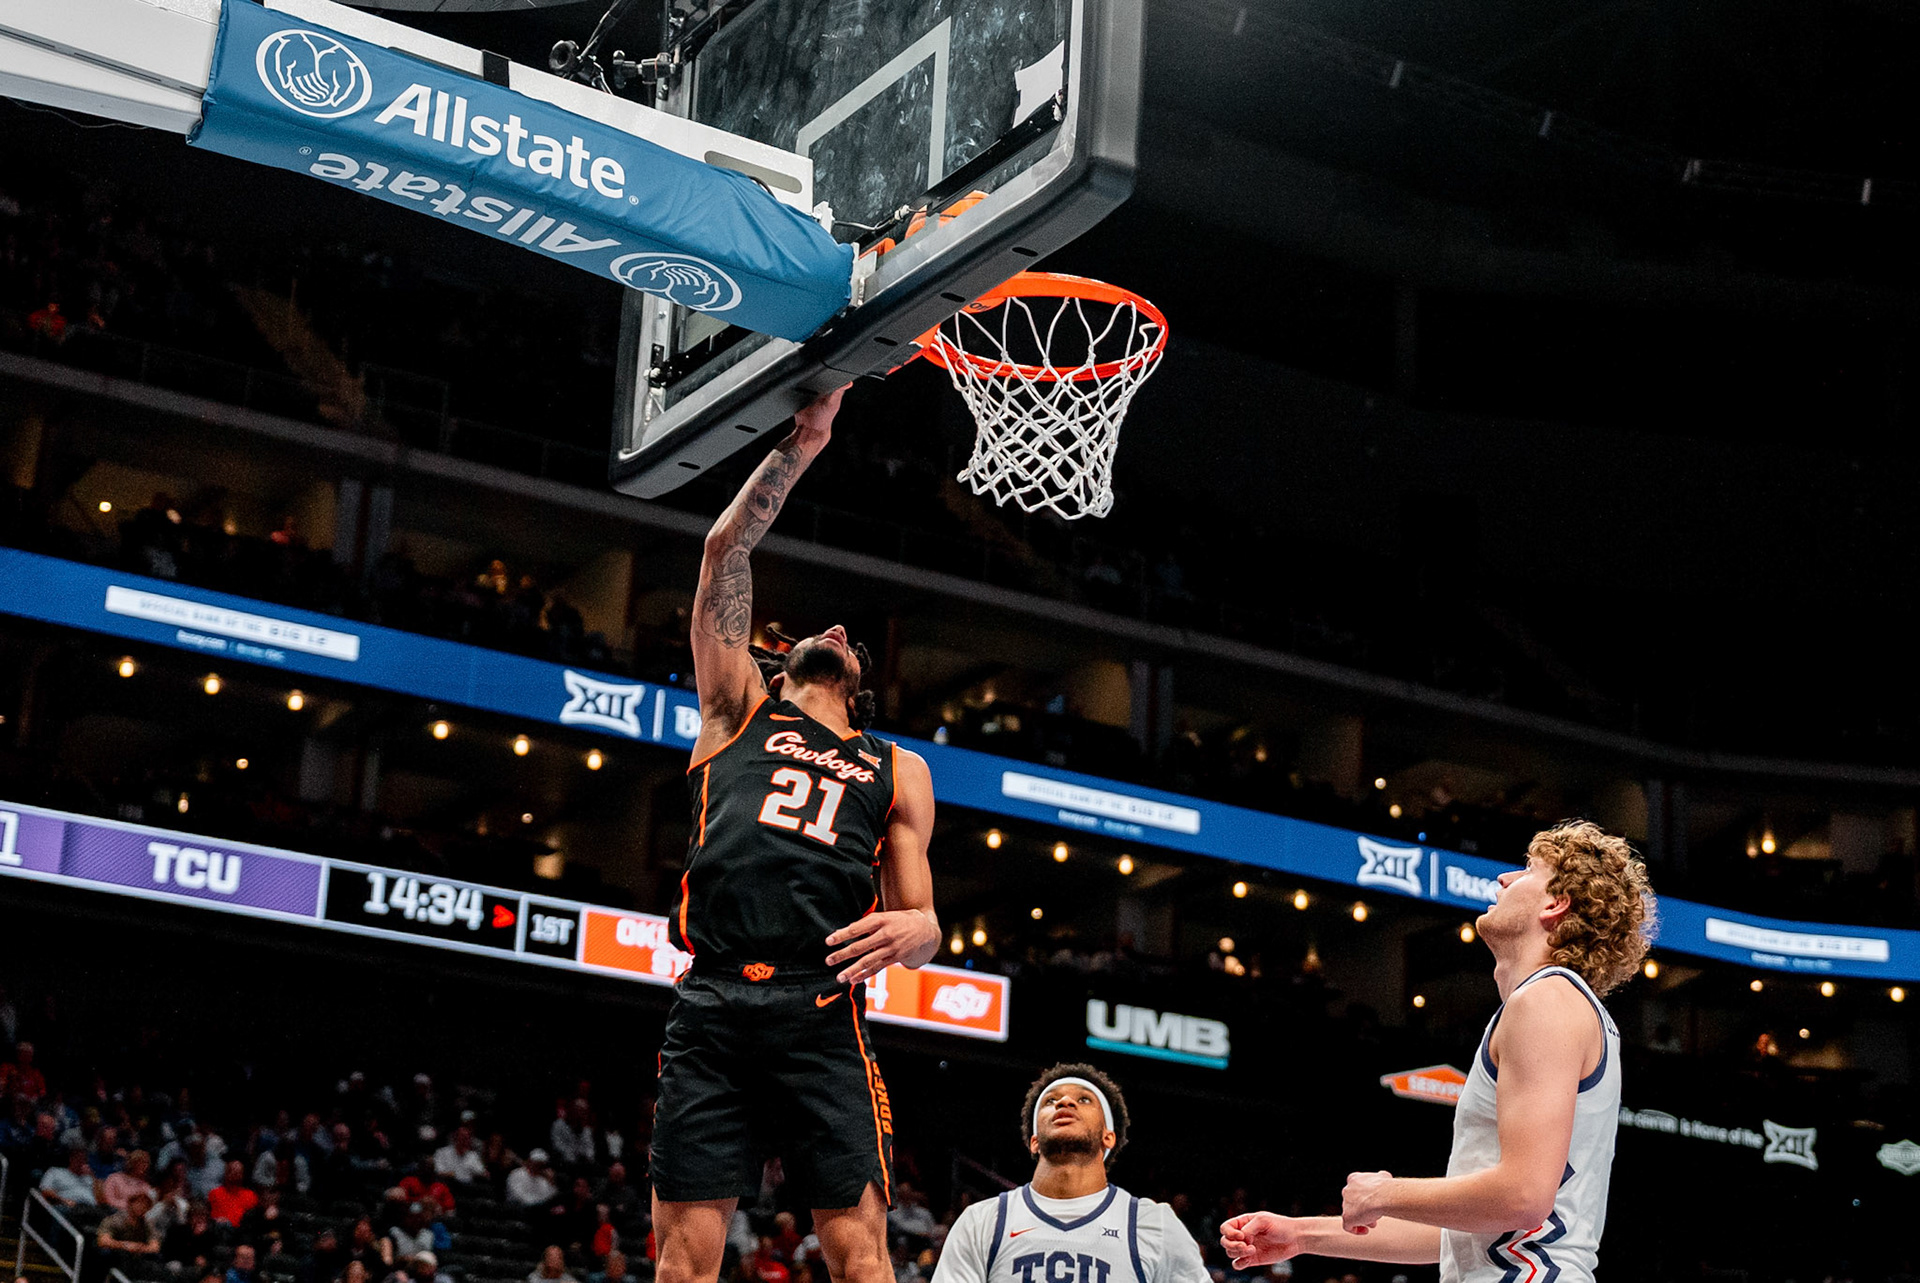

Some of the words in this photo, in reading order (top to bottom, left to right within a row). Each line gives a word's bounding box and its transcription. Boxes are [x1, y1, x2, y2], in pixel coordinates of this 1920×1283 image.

[374, 83, 626, 199] Allstate
[310, 153, 622, 253] Allstate
[764, 730, 875, 783] Cowboys
[758, 767, 847, 846] 21
[148, 841, 243, 895] TCU
[363, 872, 484, 931] 14:34
[530, 913, 575, 946] 1ST
[1086, 999, 1231, 1058] UMB
[1101, 1226, 1120, 1239] XII
[1012, 1250, 1111, 1283] TCU
